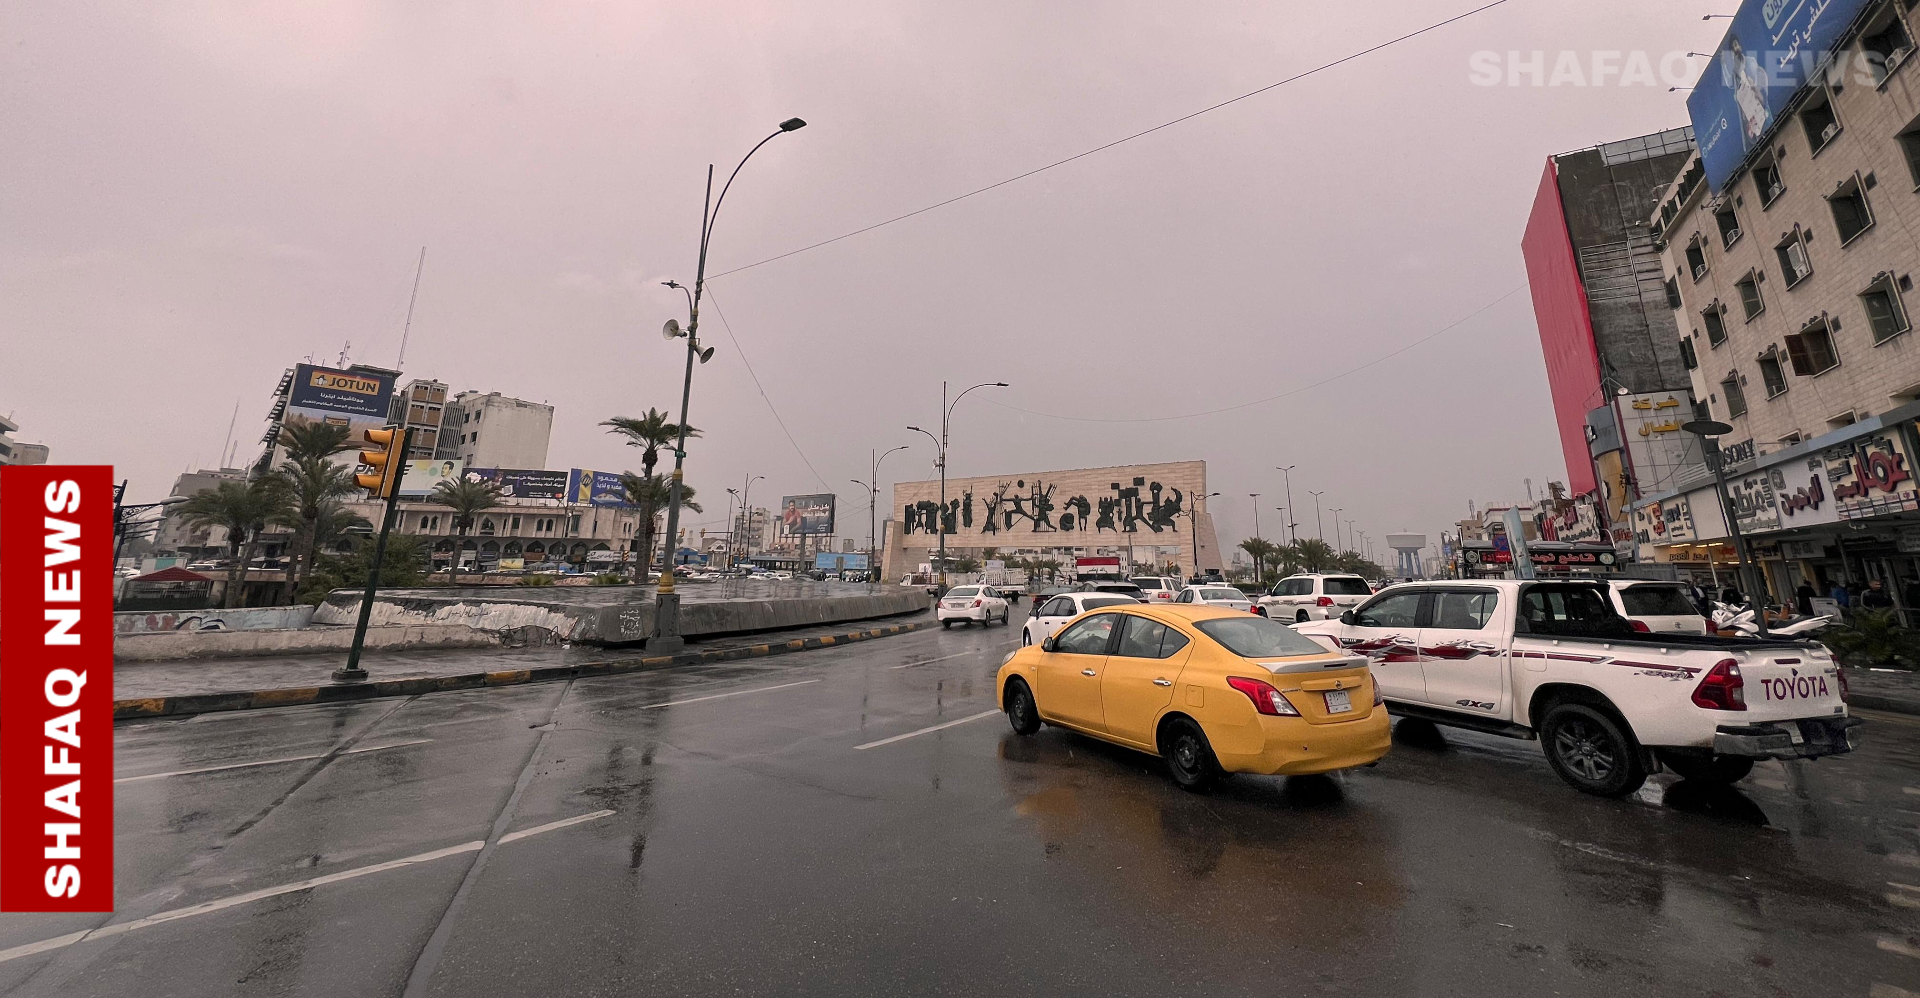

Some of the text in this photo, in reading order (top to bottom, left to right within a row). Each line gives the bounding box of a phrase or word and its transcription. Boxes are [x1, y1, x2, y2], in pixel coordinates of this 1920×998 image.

[328, 377, 377, 393] JOTUN
[1631, 395, 1680, 411] شركة
[1760, 675, 1829, 701] TOYOTA
